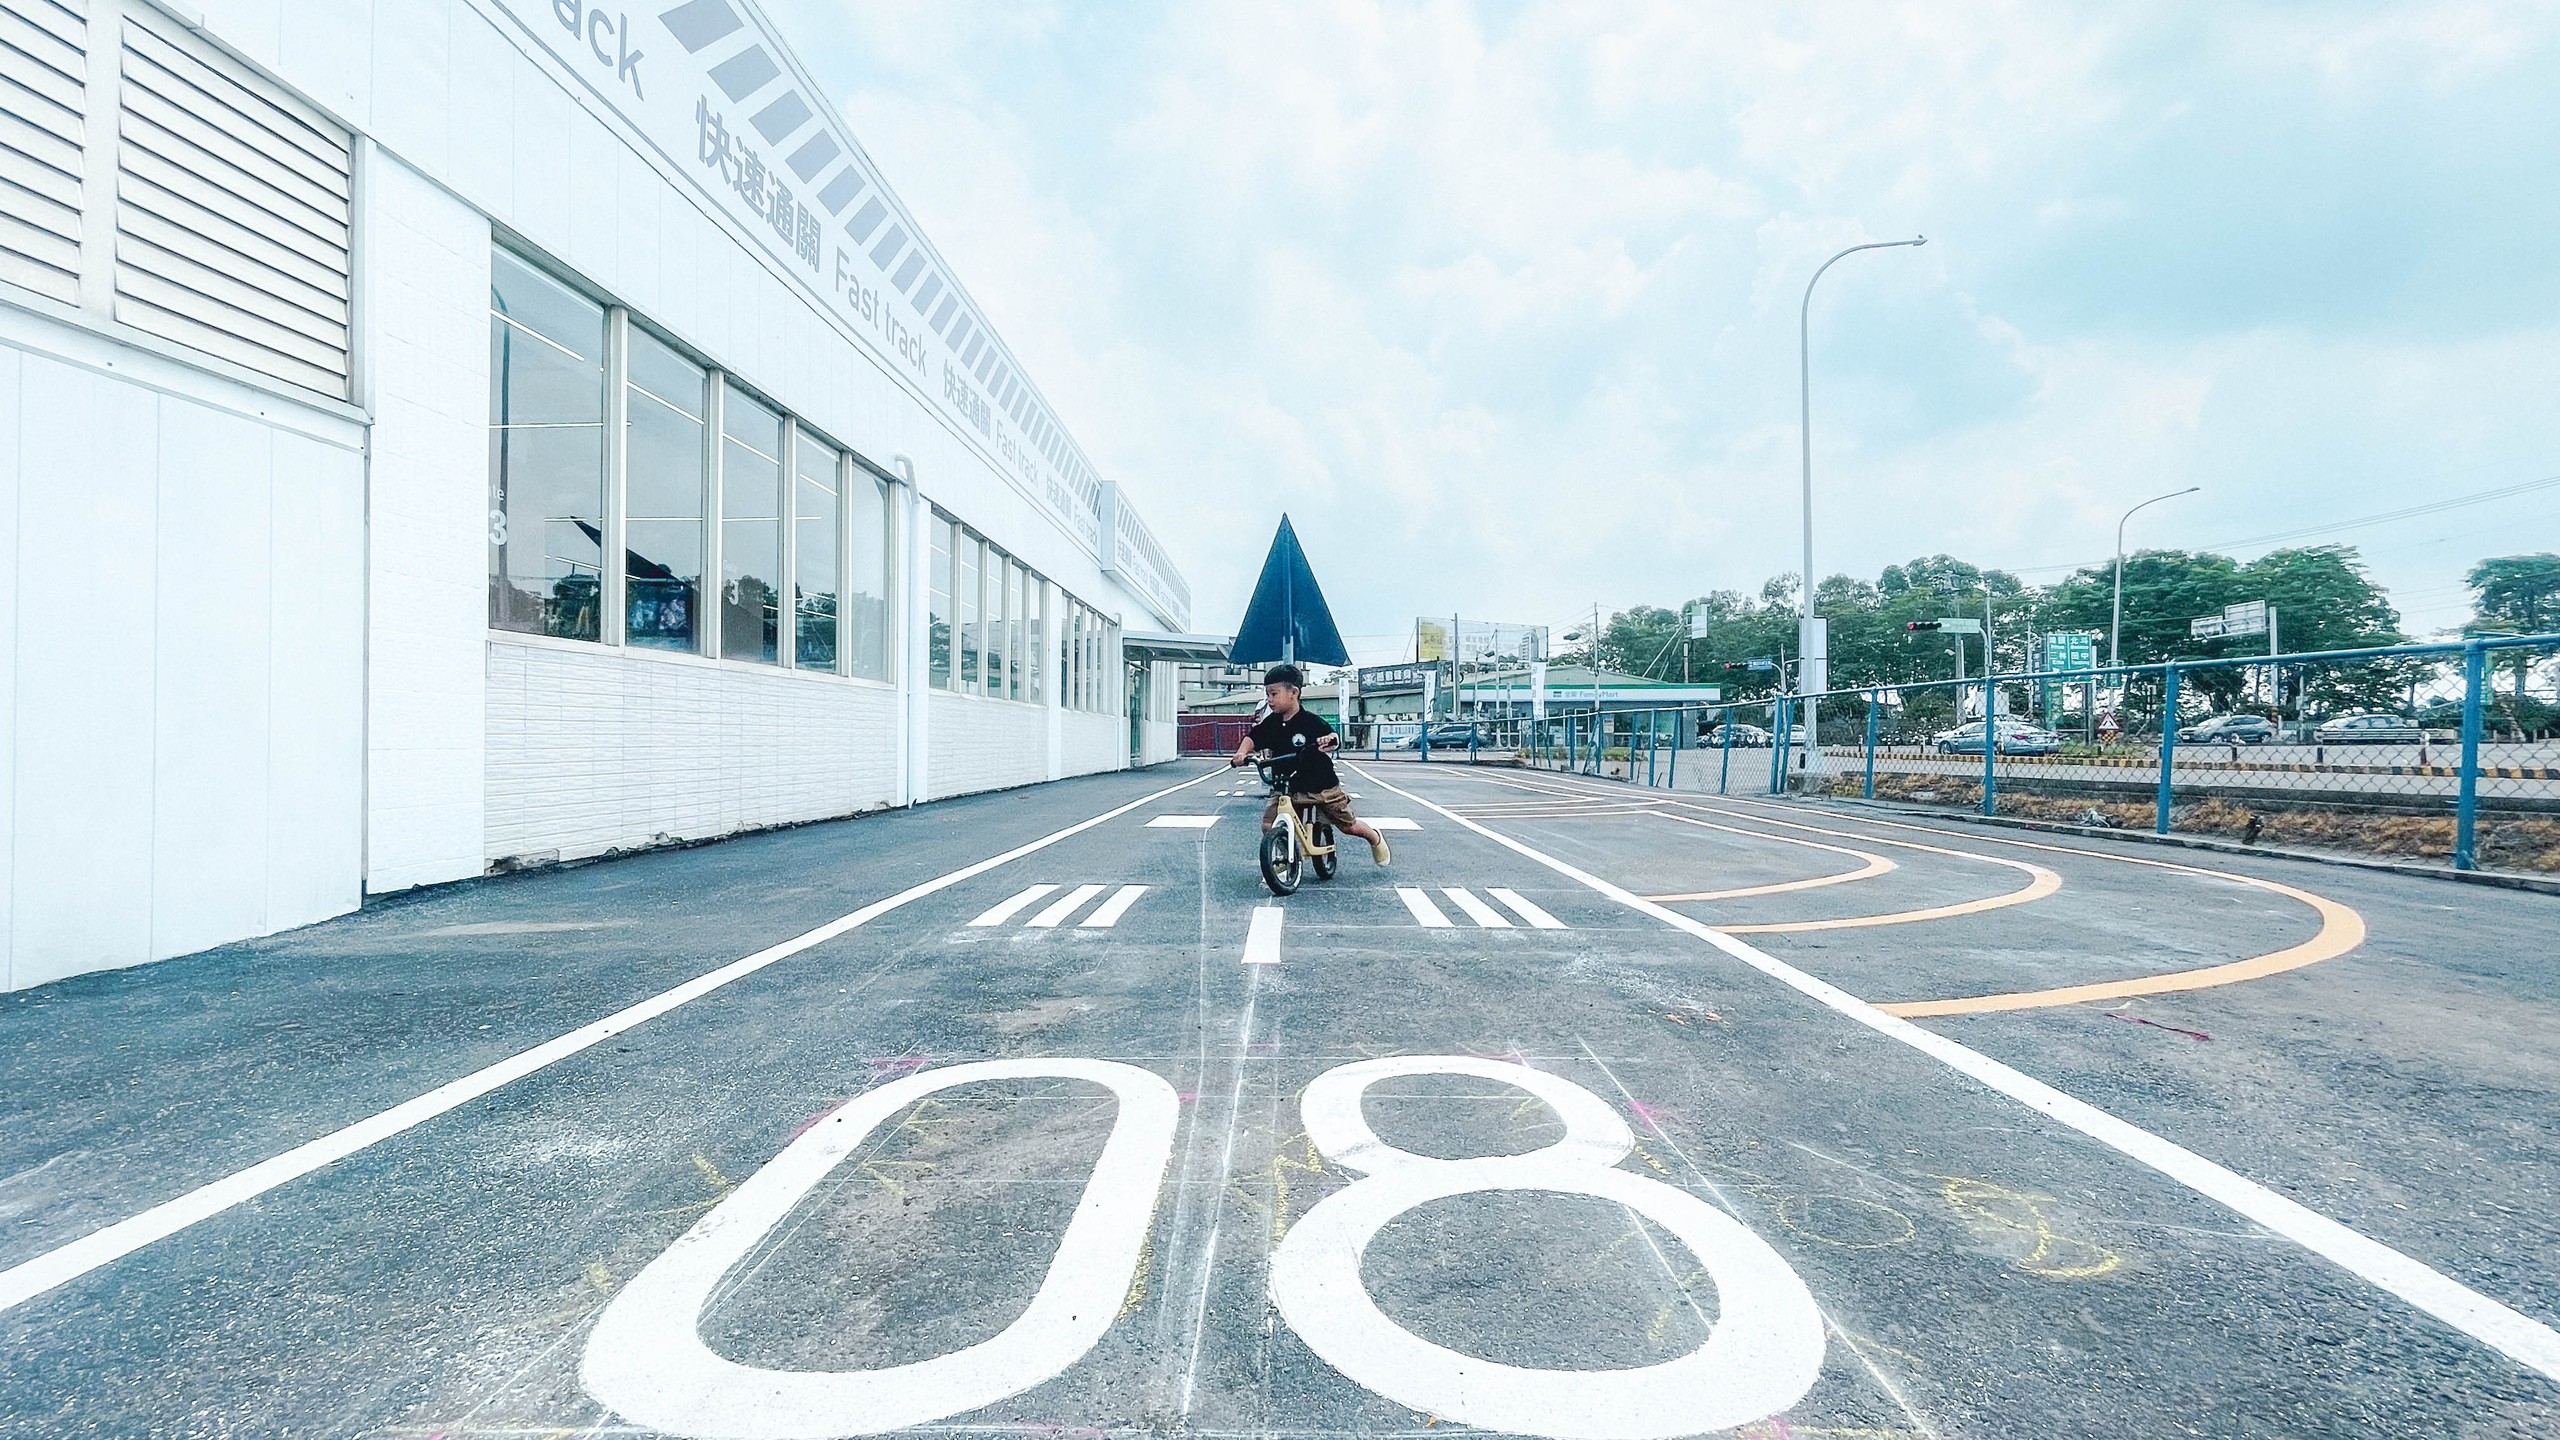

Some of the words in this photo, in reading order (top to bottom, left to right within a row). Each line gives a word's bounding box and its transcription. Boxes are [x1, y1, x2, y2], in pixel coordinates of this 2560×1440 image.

[695, 94, 821, 273] 快速通關
[835, 245, 879, 330] Fast
[885, 302, 927, 377] track
[996, 419, 1016, 465] Fast
[1018, 444, 1039, 488] track
[489, 509, 507, 545] 3
